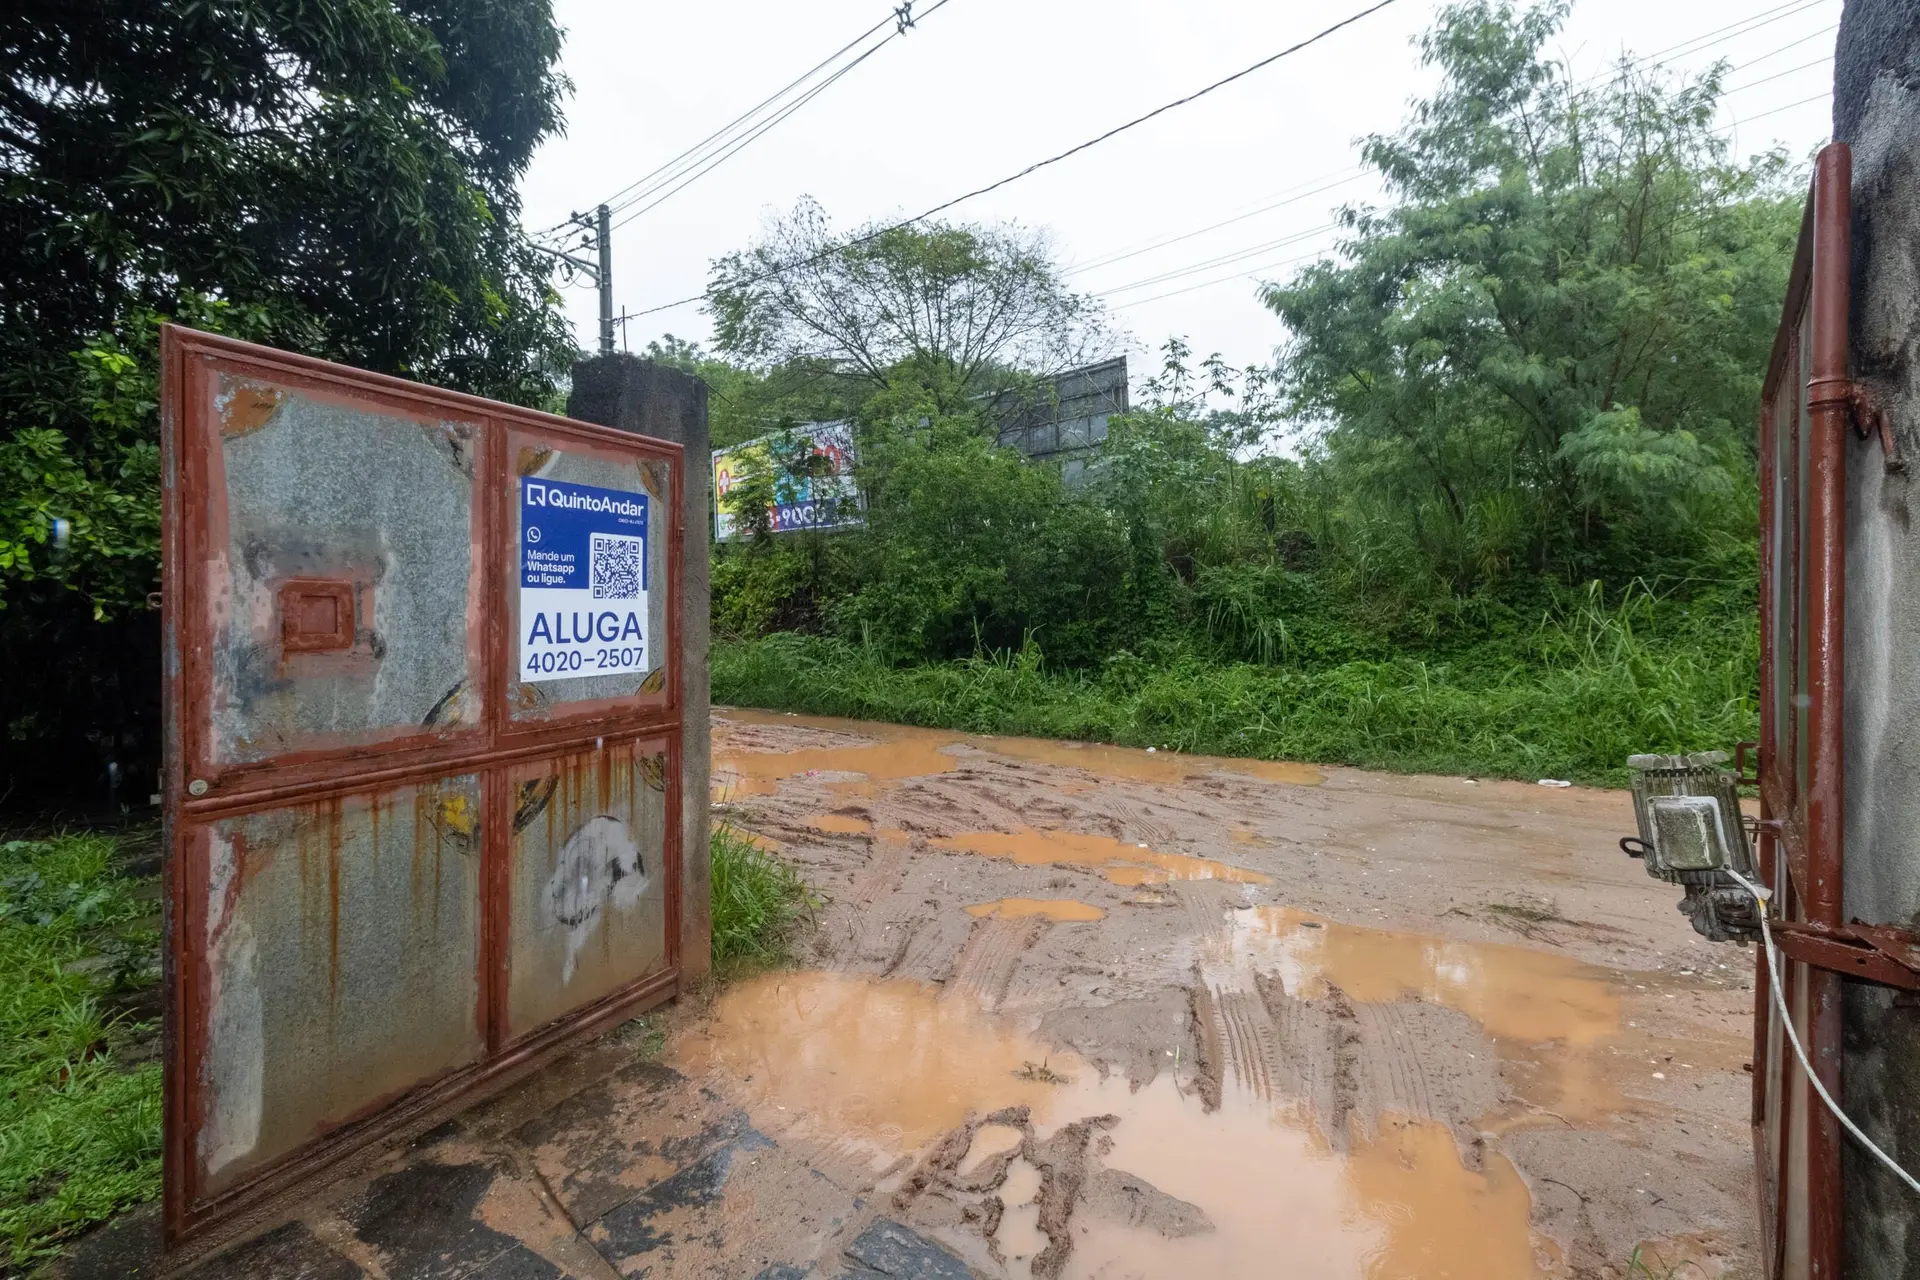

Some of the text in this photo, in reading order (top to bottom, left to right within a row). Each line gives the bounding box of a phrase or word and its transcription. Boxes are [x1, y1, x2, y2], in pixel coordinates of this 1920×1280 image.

[549, 489, 644, 517] QuintoAndar
[527, 550, 575, 562] Mande um
[527, 561, 575, 574] Whatsapp
[527, 572, 566, 585] ou ligue.
[527, 611, 643, 646] ALUGA
[526, 647, 644, 674] 4020-2507
